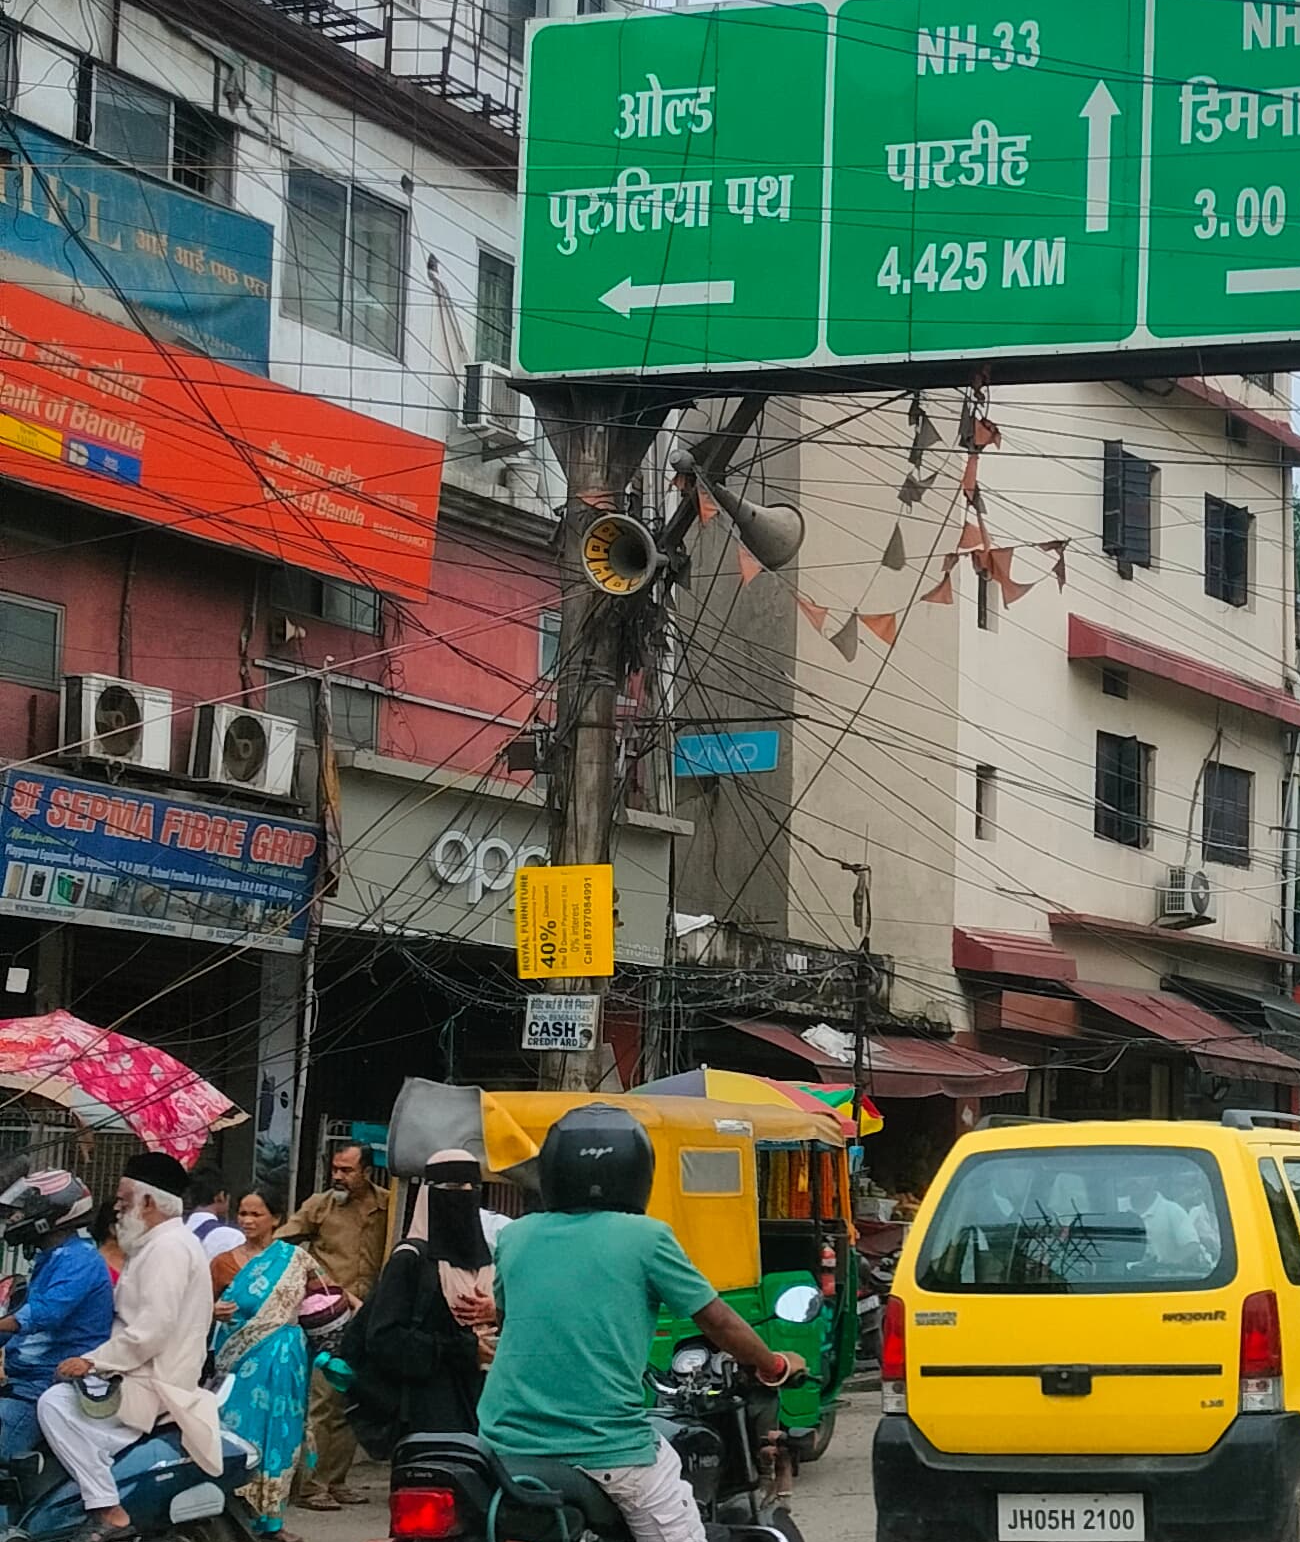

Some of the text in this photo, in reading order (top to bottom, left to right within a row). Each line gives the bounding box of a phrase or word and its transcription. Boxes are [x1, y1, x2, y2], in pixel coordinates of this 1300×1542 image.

[917, 20, 1040, 75] NH-33
[619, 73, 715, 138] ओल्ड
[886, 120, 1030, 190] पारडीह
[549, 167, 792, 255] पुरुलिया पथ
[1194, 186, 1286, 239] 3.00
[877, 238, 1066, 295] 4.425 KM
[0, 371, 41, 417] ank
[44, 396, 69, 425] of
[69, 400, 146, 451] Baroda
[301, 490, 318, 512] of
[317, 492, 366, 526] Baroda
[46, 785, 155, 843] SEPMA
[159, 806, 249, 859] FIBRE
[250, 823, 318, 870] GRIP
[519, 874, 530, 971] ROYAL FURNITURE
[539, 920, 557, 969] 40%
[570, 938, 579, 953] 0%
[583, 943, 592, 965] Call
[527, 1037, 558, 1046] CREDIT
[528, 1021, 577, 1038] CASH
[1007, 1508, 1135, 1531] JH05H 2100
